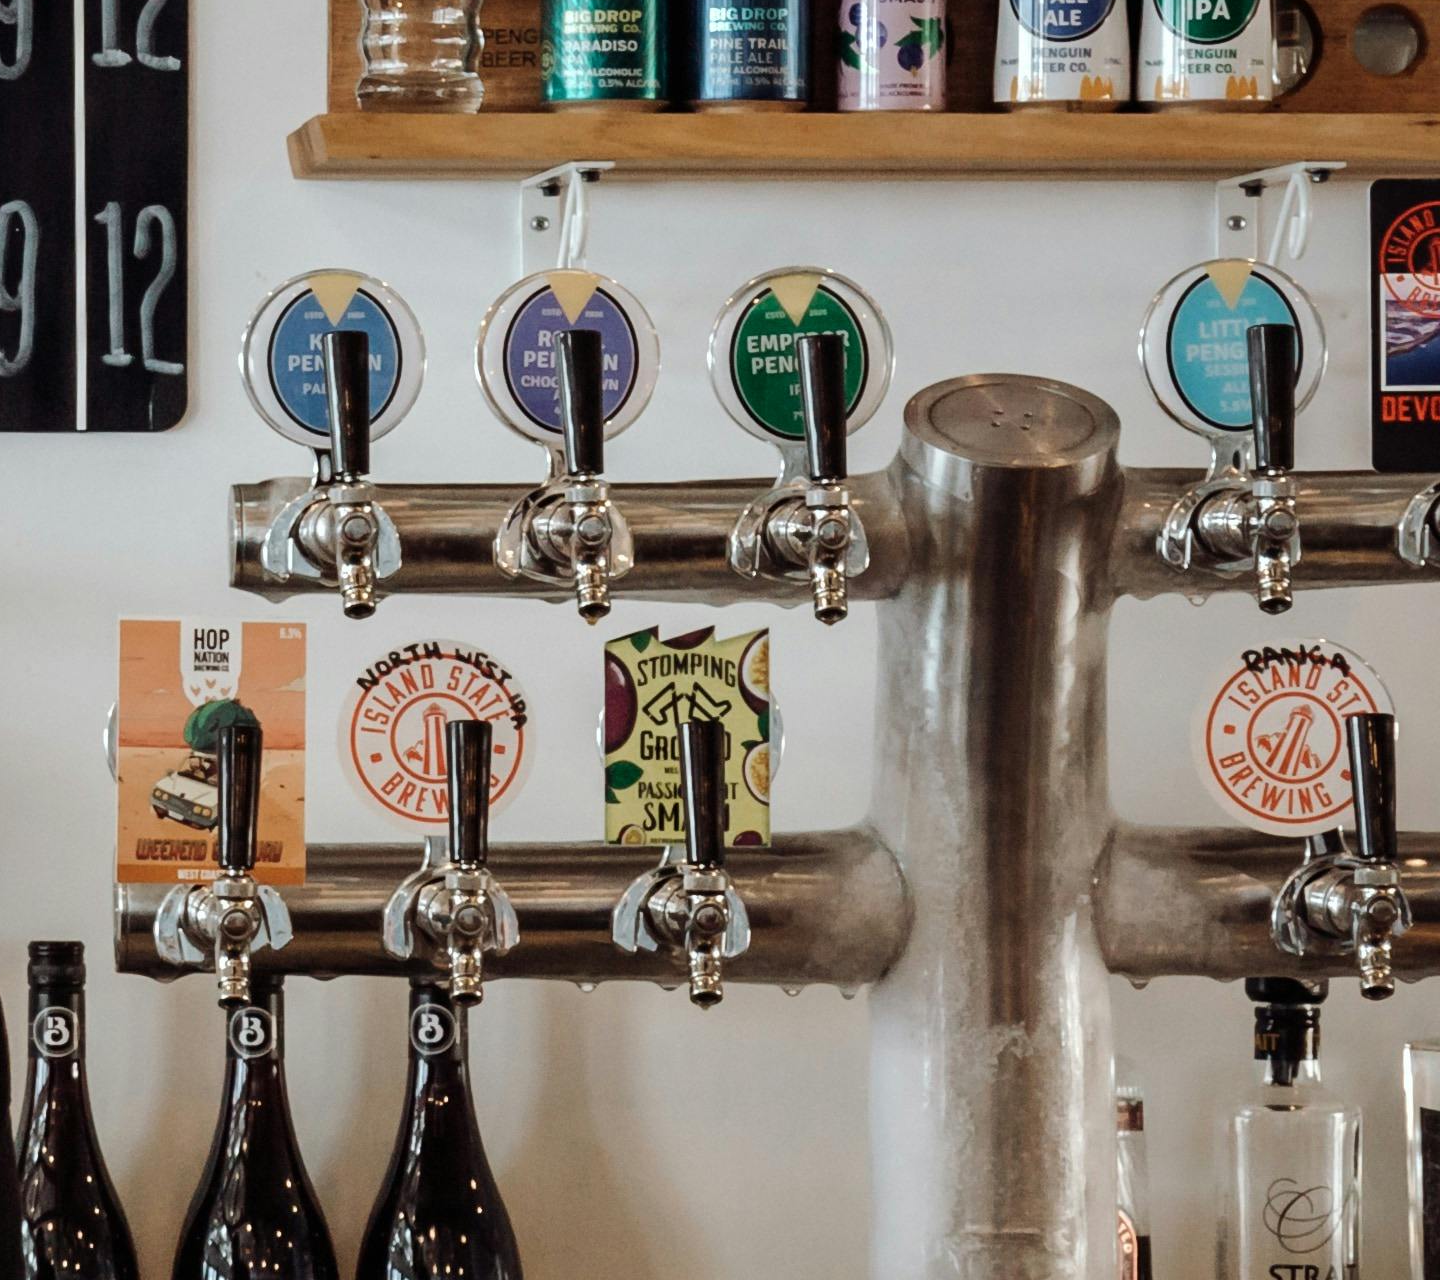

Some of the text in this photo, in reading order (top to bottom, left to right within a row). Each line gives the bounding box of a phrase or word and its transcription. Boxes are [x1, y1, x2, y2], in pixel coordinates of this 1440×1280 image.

[742, 8, 788, 20] DROP
[1187, 0, 1230, 20] IPA
[710, 38, 743, 50] PINE
[194, 629, 229, 649] HOP
[194, 651, 229, 663] NATION
[356, 642, 441, 691] NORTH
[637, 653, 736, 687] STOMPING
[361, 664, 434, 734] ISLAND
[1220, 752, 1333, 814] BREWING
